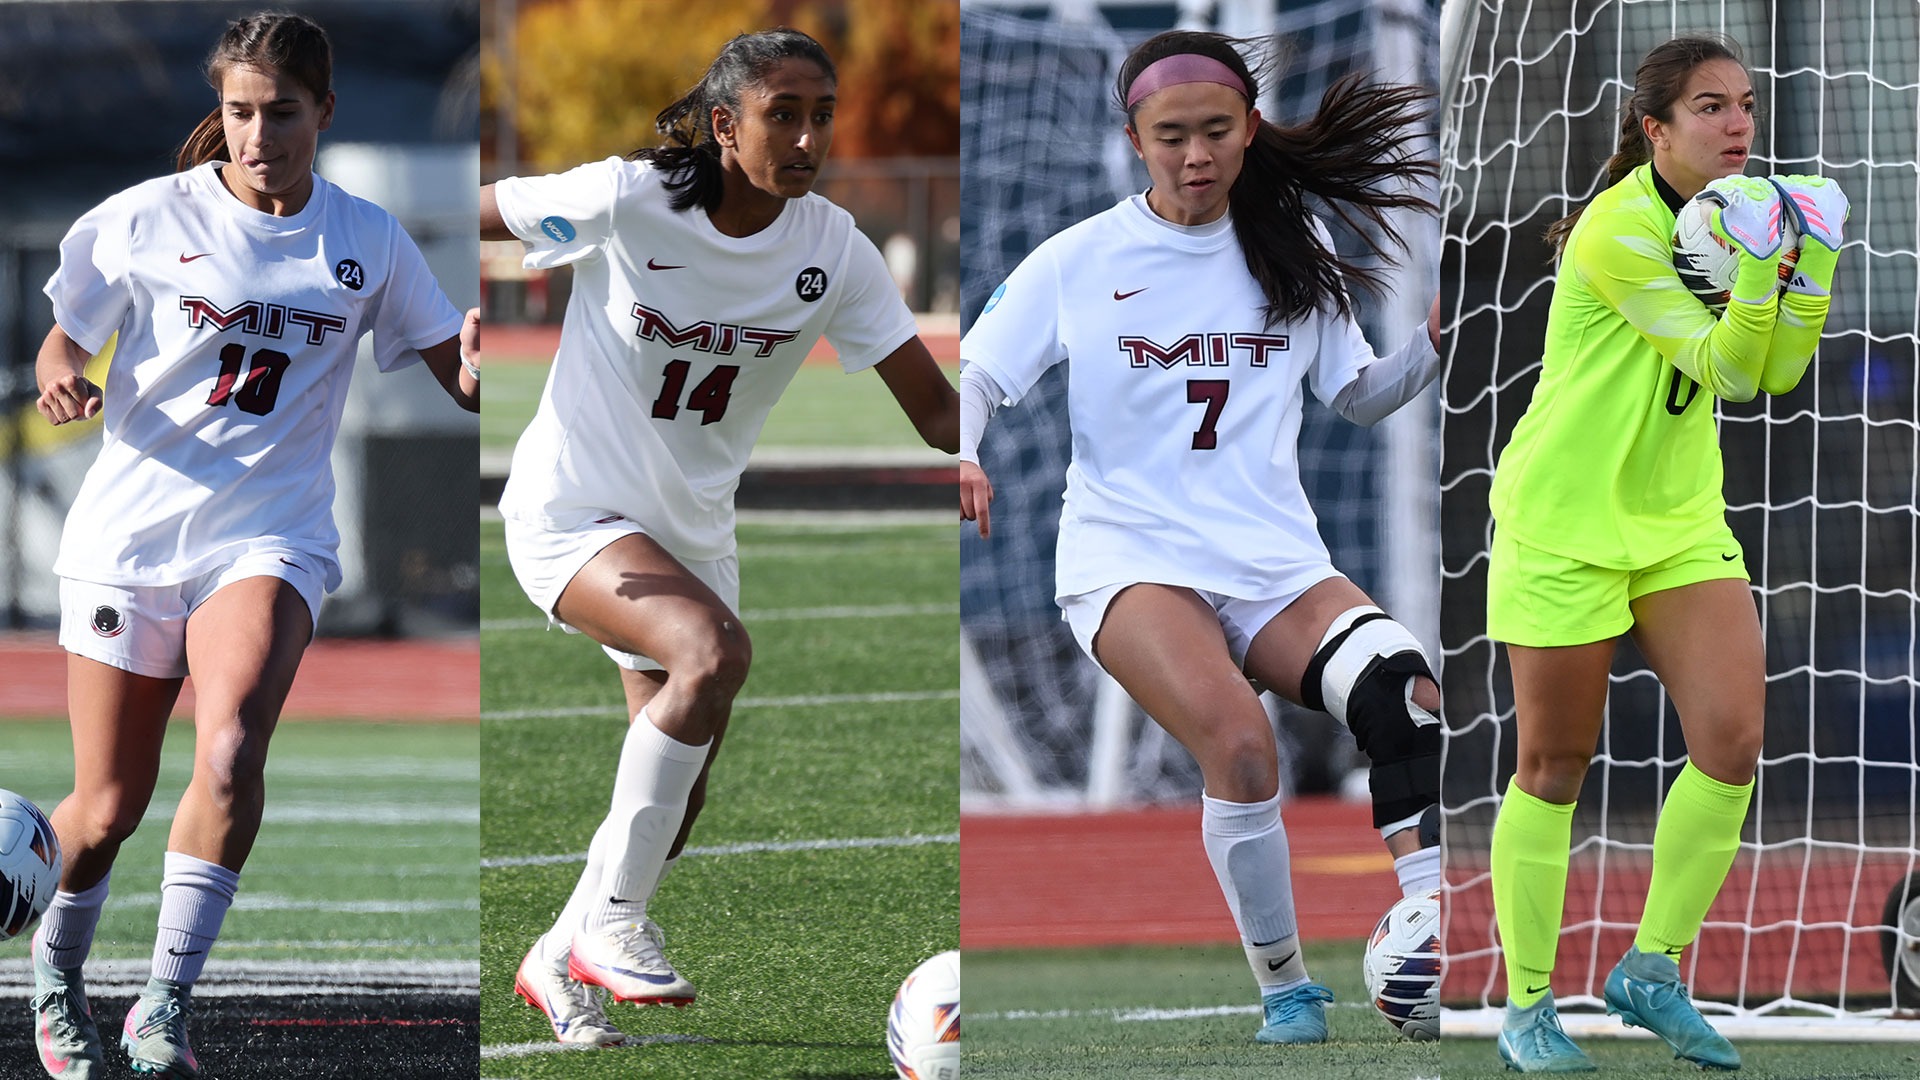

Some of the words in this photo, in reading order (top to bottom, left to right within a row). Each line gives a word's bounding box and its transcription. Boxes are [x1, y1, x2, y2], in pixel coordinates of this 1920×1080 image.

[544, 221, 568, 242] NCAA
[340, 263, 362, 286] 24
[800, 273, 823, 296] 24
[180, 295, 346, 346] MIT
[631, 302, 801, 357] MIT
[1118, 333, 1290, 370] MIT
[205, 343, 291, 416] 10
[651, 359, 740, 426] 14
[1186, 379, 1230, 450] 7
